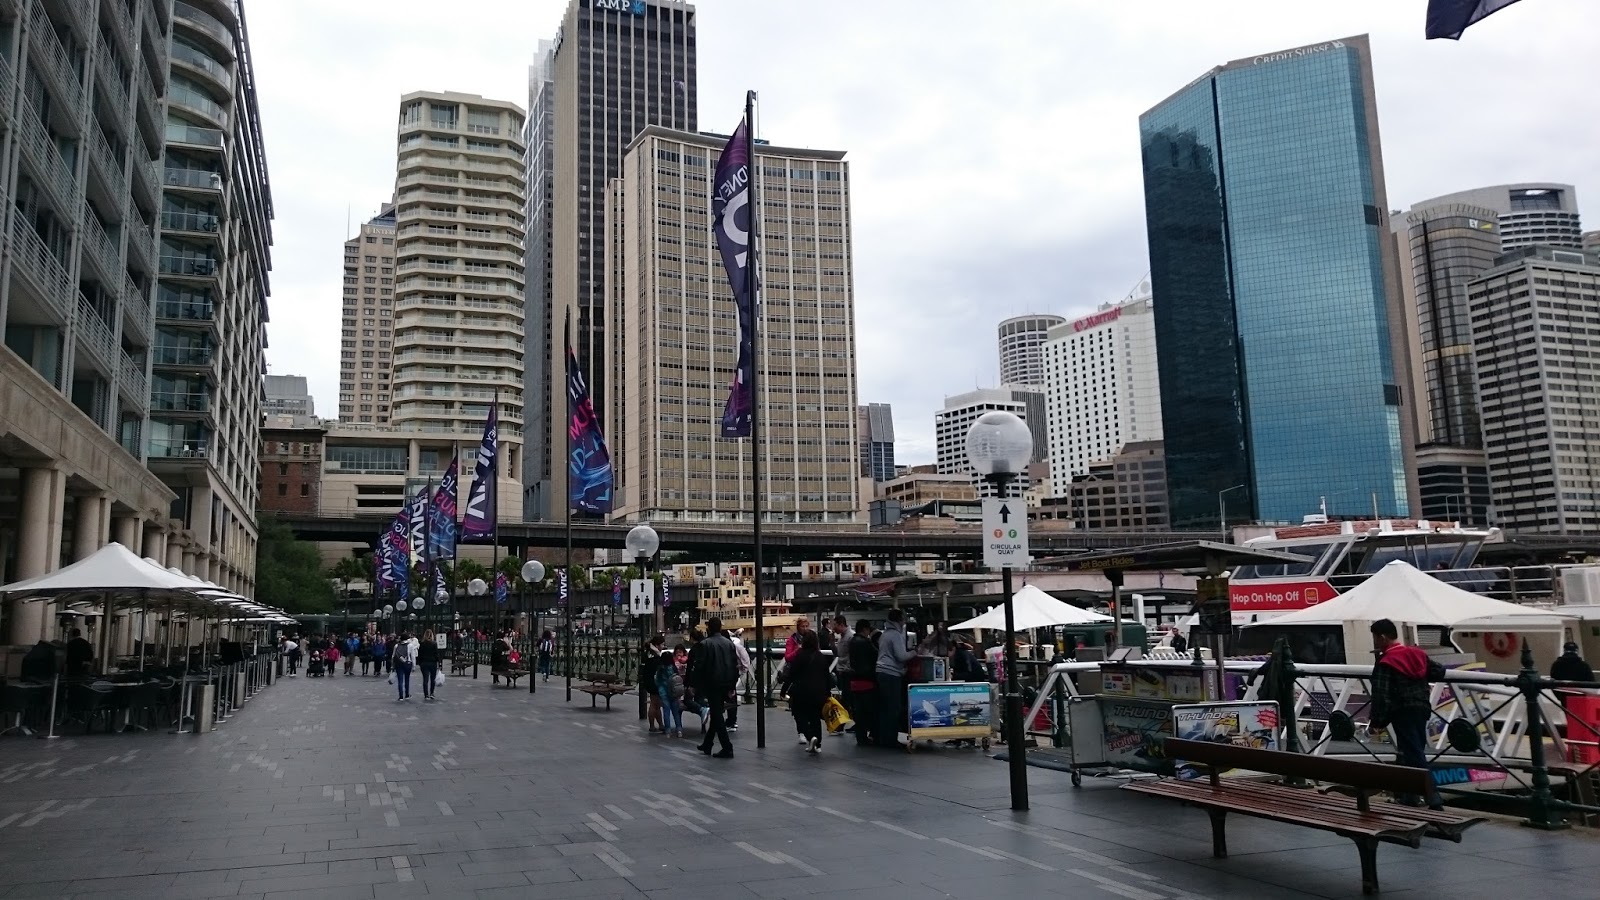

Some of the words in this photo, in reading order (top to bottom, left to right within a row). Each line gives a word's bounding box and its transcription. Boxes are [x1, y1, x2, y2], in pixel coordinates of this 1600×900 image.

[597, 0, 630, 11] AMP
[1253, 51, 1293, 65] CREDIT
[1294, 43, 1330, 57] SUISSE
[1469, 218, 1478, 229] EY
[1084, 306, 1122, 331] Marriott
[1078, 561, 1091, 570] Jet
[1092, 558, 1111, 568] Boat
[1112, 556, 1135, 566] Rides
[1232, 594, 1249, 605] Hop
[1251, 592, 1264, 602] On
[1265, 592, 1283, 604] Hop
[1285, 590, 1300, 602] Off
[1114, 704, 1172, 720] THUND
[1180, 711, 1239, 720] THUNDER
